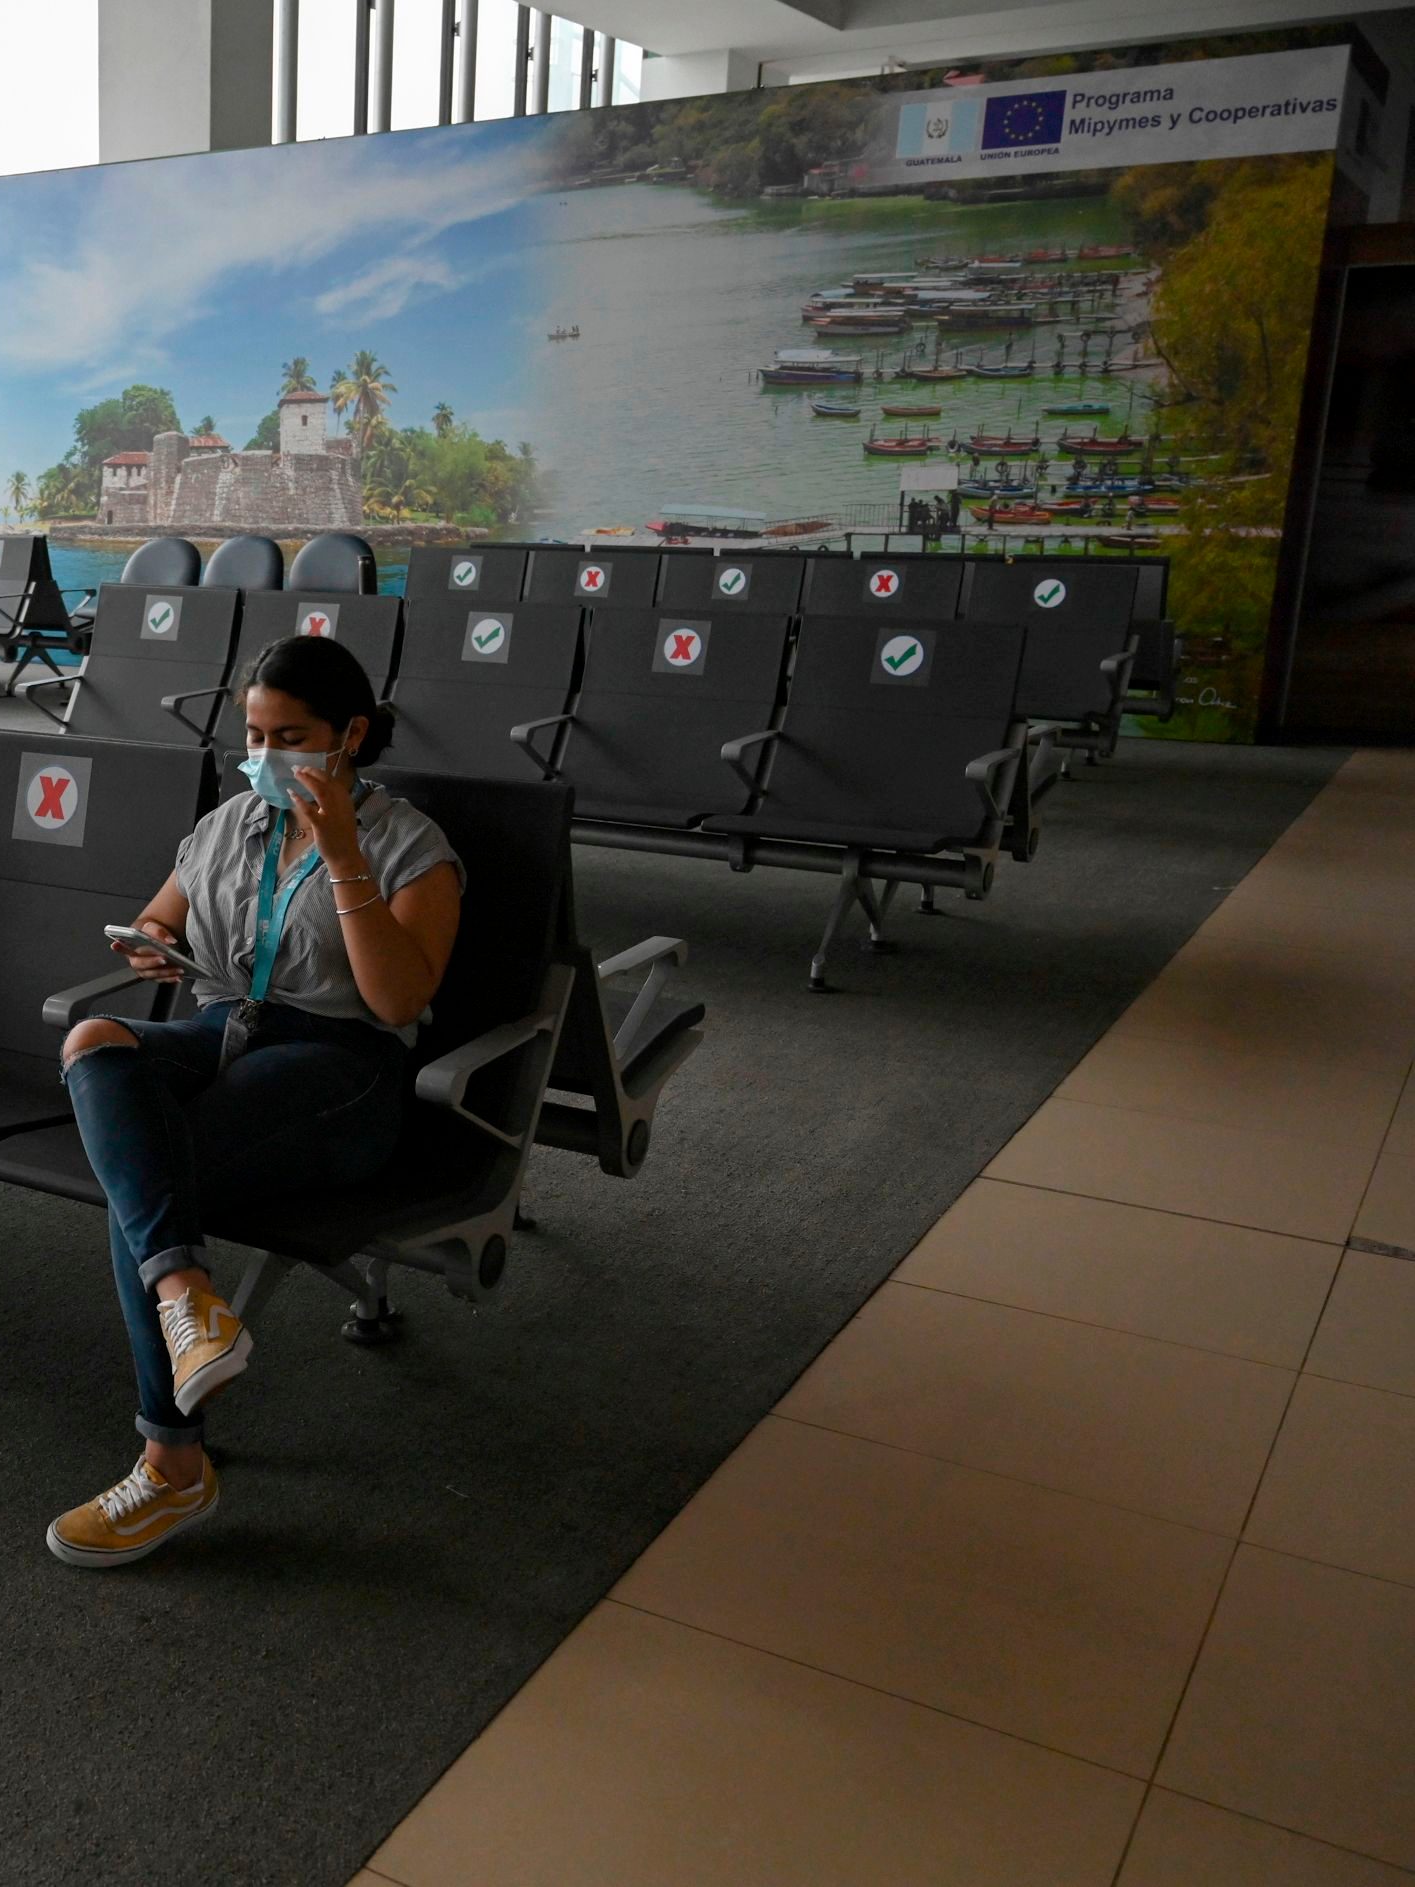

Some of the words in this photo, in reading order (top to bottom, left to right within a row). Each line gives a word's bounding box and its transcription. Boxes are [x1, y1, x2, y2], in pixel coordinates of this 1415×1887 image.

[1071, 86, 1175, 114] Programa
[1068, 114, 1162, 137] Mipymes
[1168, 113, 1181, 130] y
[1188, 95, 1338, 129] Cooperativas
[905, 155, 963, 167] GUATEMALA
[1013, 147, 1060, 158] EUROPEA
